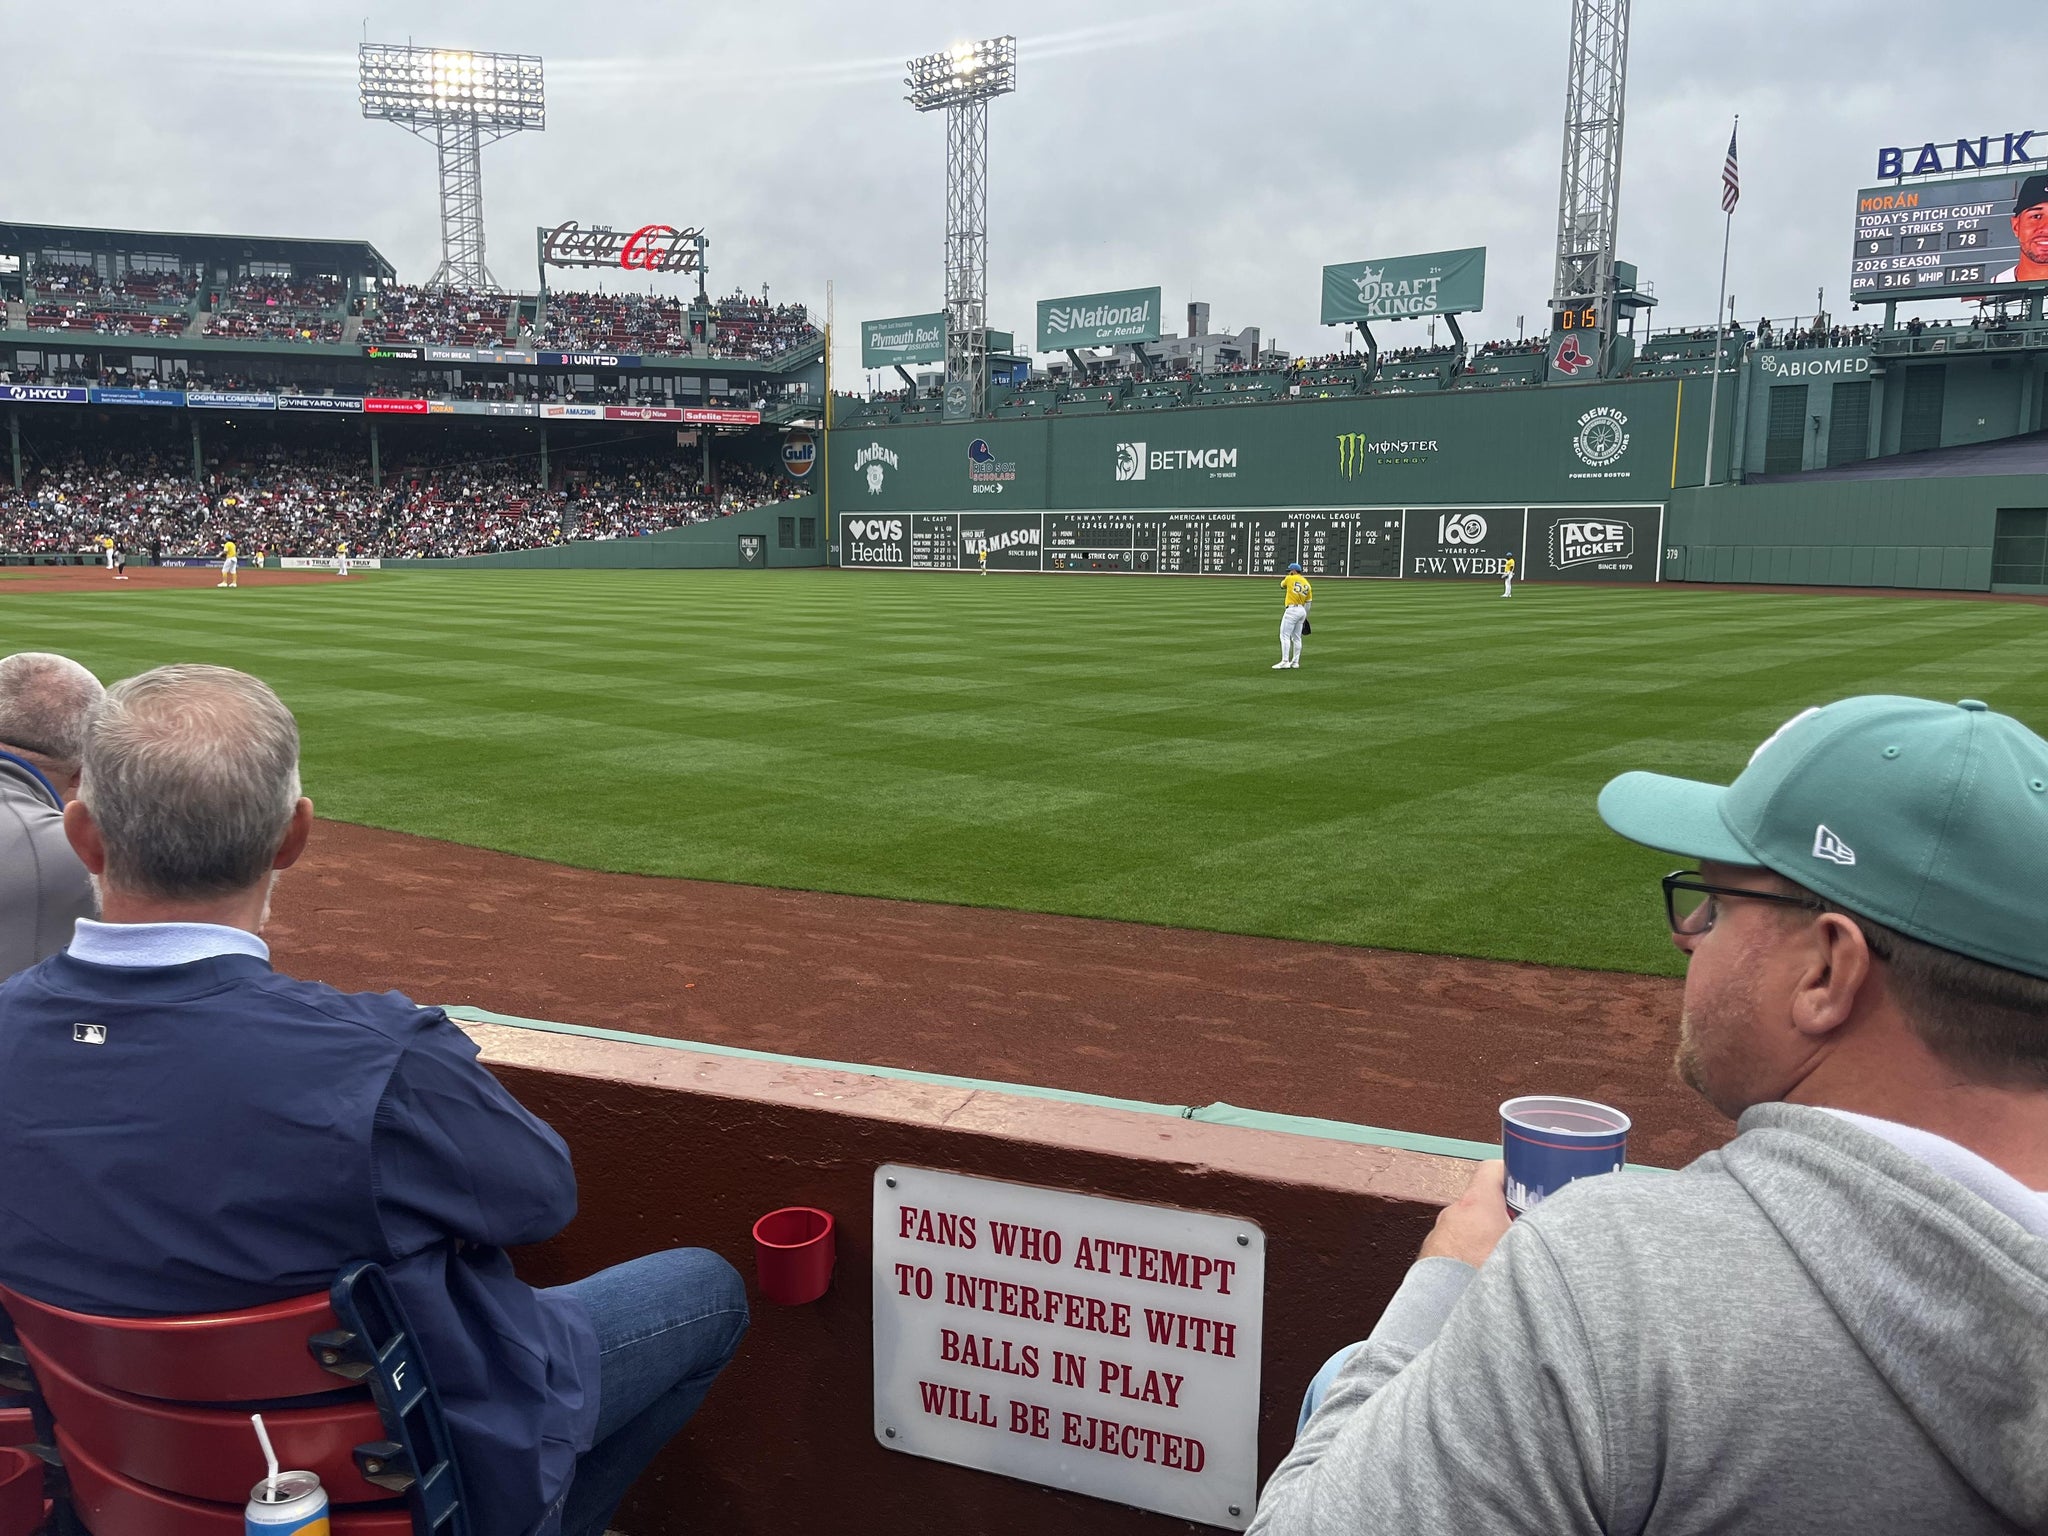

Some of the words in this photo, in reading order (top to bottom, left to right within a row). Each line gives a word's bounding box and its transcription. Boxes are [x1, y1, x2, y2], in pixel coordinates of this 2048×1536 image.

[1877, 130, 2035, 181] BANK
[1860, 191, 1919, 212] MORÁN
[1859, 211, 1909, 227] TODAY'S
[1912, 208, 1948, 222] PITCH
[1951, 204, 1994, 219] COUNT
[592, 225, 612, 233] ENJOY
[1859, 228, 1893, 239] TOTAL
[1900, 222, 1944, 235] STRIKES
[1957, 218, 1979, 230] PCT
[1870, 242, 1879, 254] 9
[1916, 238, 1925, 250] 7
[1959, 233, 1977, 246] 78
[1856, 260, 1888, 272] 2026
[1891, 254, 1941, 269] SEASON
[1852, 277, 1875, 289] ERA
[1884, 273, 1911, 287] 3.16
[1918, 271, 1944, 284] WHIP
[1950, 268, 1979, 282] 1.25
[1358, 277, 1441, 304] DRAFT
[1070, 300, 1149, 330] National
[1367, 295, 1438, 317] KINGS
[871, 329, 915, 349] Plymouth
[915, 326, 940, 344] Rock
[1096, 327, 1113, 338] Car
[1114, 324, 1145, 337] Rental
[432, 351, 450, 359] PITCH
[451, 352, 471, 360] BREAK
[908, 342, 939, 351] assurance
[573, 354, 618, 366] UNITED
[1776, 357, 1869, 377] ABIOMED
[29, 388, 67, 399] HYCU
[189, 394, 225, 402] COGHLIN
[225, 395, 274, 404] COMPANIES
[288, 399, 334, 408] VINEYARD
[565, 408, 597, 416] AMAZING
[620, 410, 640, 418] Ninety
[652, 410, 667, 418] Nine
[686, 412, 722, 421] Safelite
[1577, 407, 1609, 427] IBEW
[1609, 407, 1628, 425] 103
[782, 444, 814, 460] Gulf
[854, 447, 872, 472] JIM
[871, 442, 900, 471] BEAM
[1150, 448, 1238, 470] BETMGM
[1573, 436, 1583, 458] NECA
[1581, 433, 1630, 467] CONTRACTORS
[972, 472, 1016, 481] SCHOLARS
[973, 463, 993, 473] RED
[995, 462, 1016, 472] SOX
[972, 483, 996, 494] BIDMC
[1281, 521, 1288, 529] IN
[1329, 512, 1361, 520] LEAGUE
[1331, 521, 1338, 529] IN
[865, 519, 903, 541] CVS
[1365, 530, 1378, 538] COL
[1438, 513, 1488, 545] 160
[1565, 522, 1624, 544] ACE
[741, 538, 758, 546] MLB
[1566, 541, 1624, 559] TICKET
[850, 542, 904, 562] Health
[1666, 548, 1678, 559] 379
[162, 560, 186, 568] xfinity
[1414, 557, 1448, 575] F.W.
[1294, 581, 1310, 596] 52
[898, 1205, 977, 1249] FANS
[989, 1220, 1062, 1264] WHO
[1073, 1236, 1236, 1295] ATTEMPT
[895, 1263, 933, 1300] TO
[944, 1271, 1132, 1338] INTERFERE
[1143, 1308, 1237, 1358] WITH
[392, 1361, 407, 1391] F
[940, 1328, 1040, 1379] BALLS
[1051, 1351, 1087, 1388] IN
[1098, 1359, 1185, 1408] PLAY
[918, 1380, 998, 1429] WILL
[1008, 1400, 1050, 1440] BE
[1061, 1411, 1206, 1473] EJECTED
